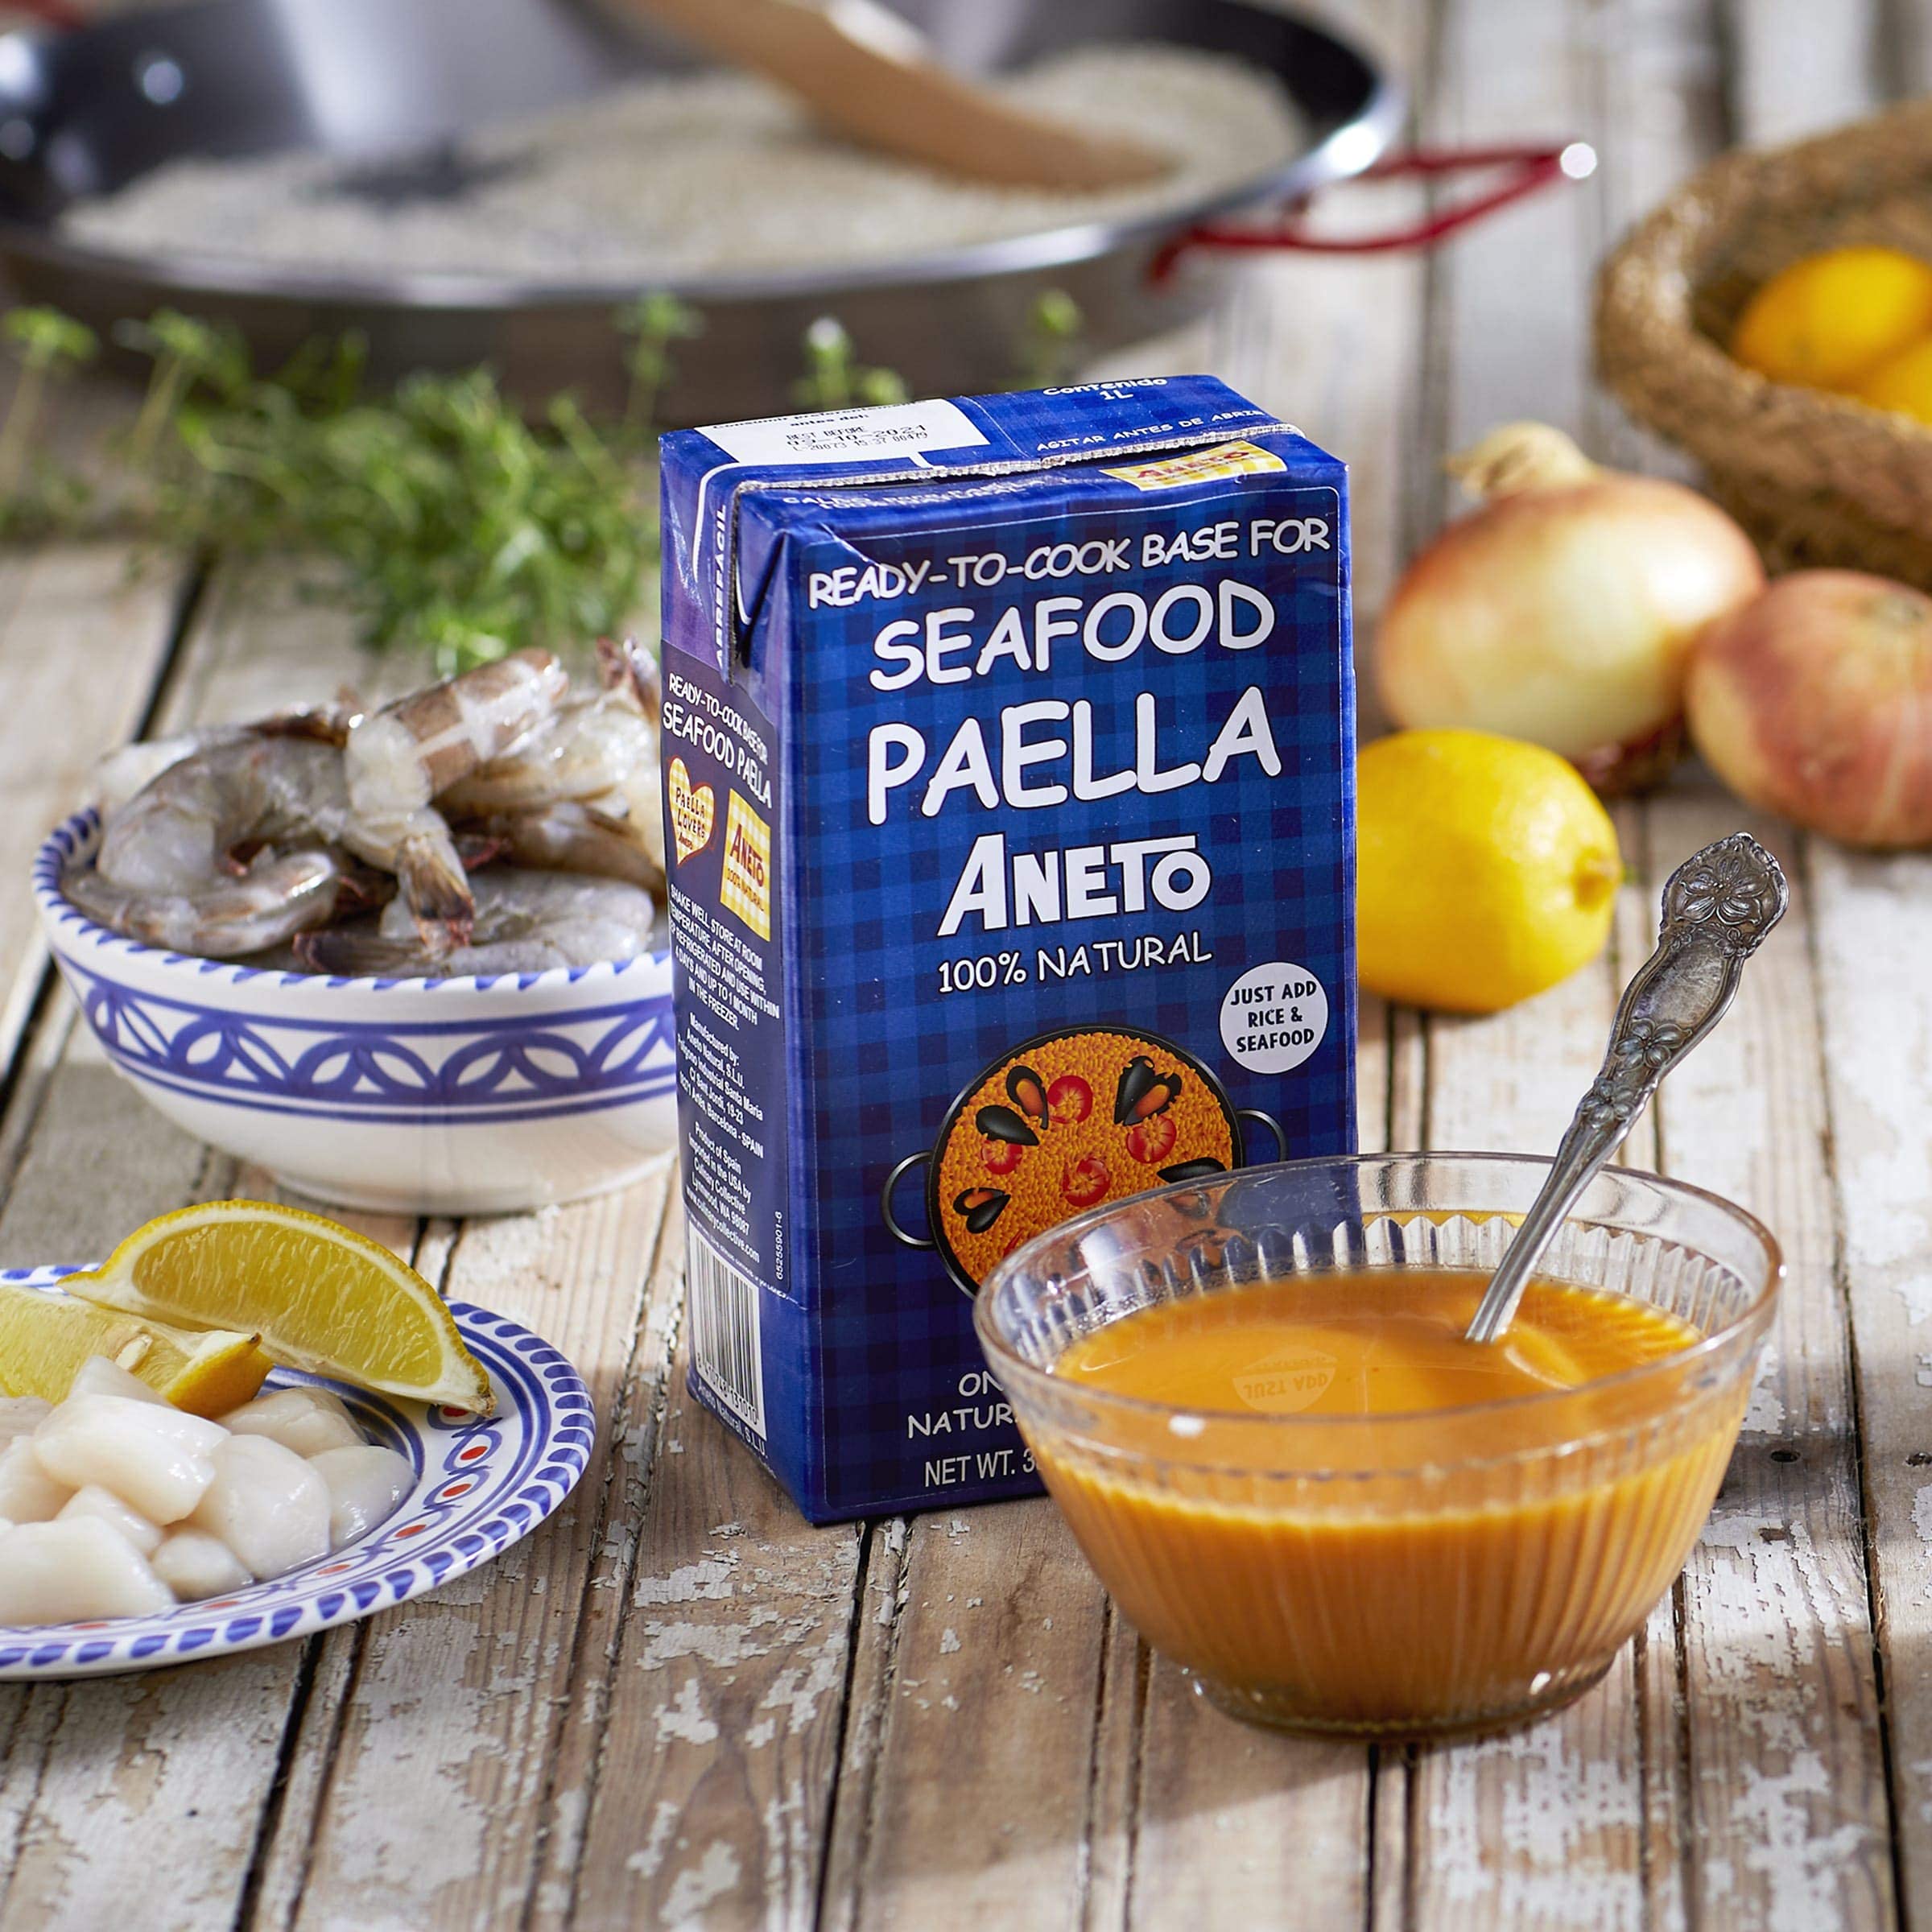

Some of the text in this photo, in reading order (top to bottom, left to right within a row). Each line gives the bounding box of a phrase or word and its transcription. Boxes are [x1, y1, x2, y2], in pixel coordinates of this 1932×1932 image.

[1099, 390, 1133, 400] 1L
[1037, 435, 1104, 451] AGITAR
[1113, 424, 1173, 440] ANTES
[1179, 417, 1203, 427] DE
[809, 518, 1331, 609] READY-TO-COOK BASE FOR
[869, 580, 1275, 691] SEAFOOD
[669, 672, 742, 736] READY-TO-COOK
[663, 701, 772, 809] SEAFOOD PAELLA
[868, 686, 1282, 825] PAELLA
[675, 786, 705, 819] PAELLA
[677, 808, 706, 839] LOVERS
[730, 824, 764, 887] ANETO
[936, 832, 1212, 937] ANETO
[671, 883, 691, 913] SHAKE
[711, 919, 734, 947] STORE
[733, 937, 742, 954] AT
[742, 943, 762, 972] ROOM
[676, 927, 721, 976] REFRIGERATED
[721, 967, 736, 989] AND
[736, 978, 749, 1001] USE
[749, 989, 779, 1019] WITHIN
[712, 940, 734, 968] AFTER
[938, 931, 1212, 993] 100% NATURAL
[679, 947, 694, 973] DAYS
[694, 964, 707, 984] AND
[708, 974, 716, 992] UP
[717, 982, 728, 1001] TO
[733, 995, 758, 1025] MONTH
[688, 976, 696, 993] IN
[696, 982, 708, 1005] THE
[1230, 980, 1317, 1006] JUST ADD
[690, 1012, 729, 1057] Manufactured
[1248, 1006, 1302, 1028] RICE &
[1236, 1028, 1315, 1053] SEAFOOD
[695, 1121, 741, 1175] Product of Spain
[741, 1132, 763, 1158] SPAIN
[715, 1179, 745, 1215] Collective
[728, 1171, 742, 1195] USA
[742, 1183, 751, 1203] by
[908, 1403, 1018, 1439] NATUR
[925, 1448, 1042, 1488] NET WT. 3
